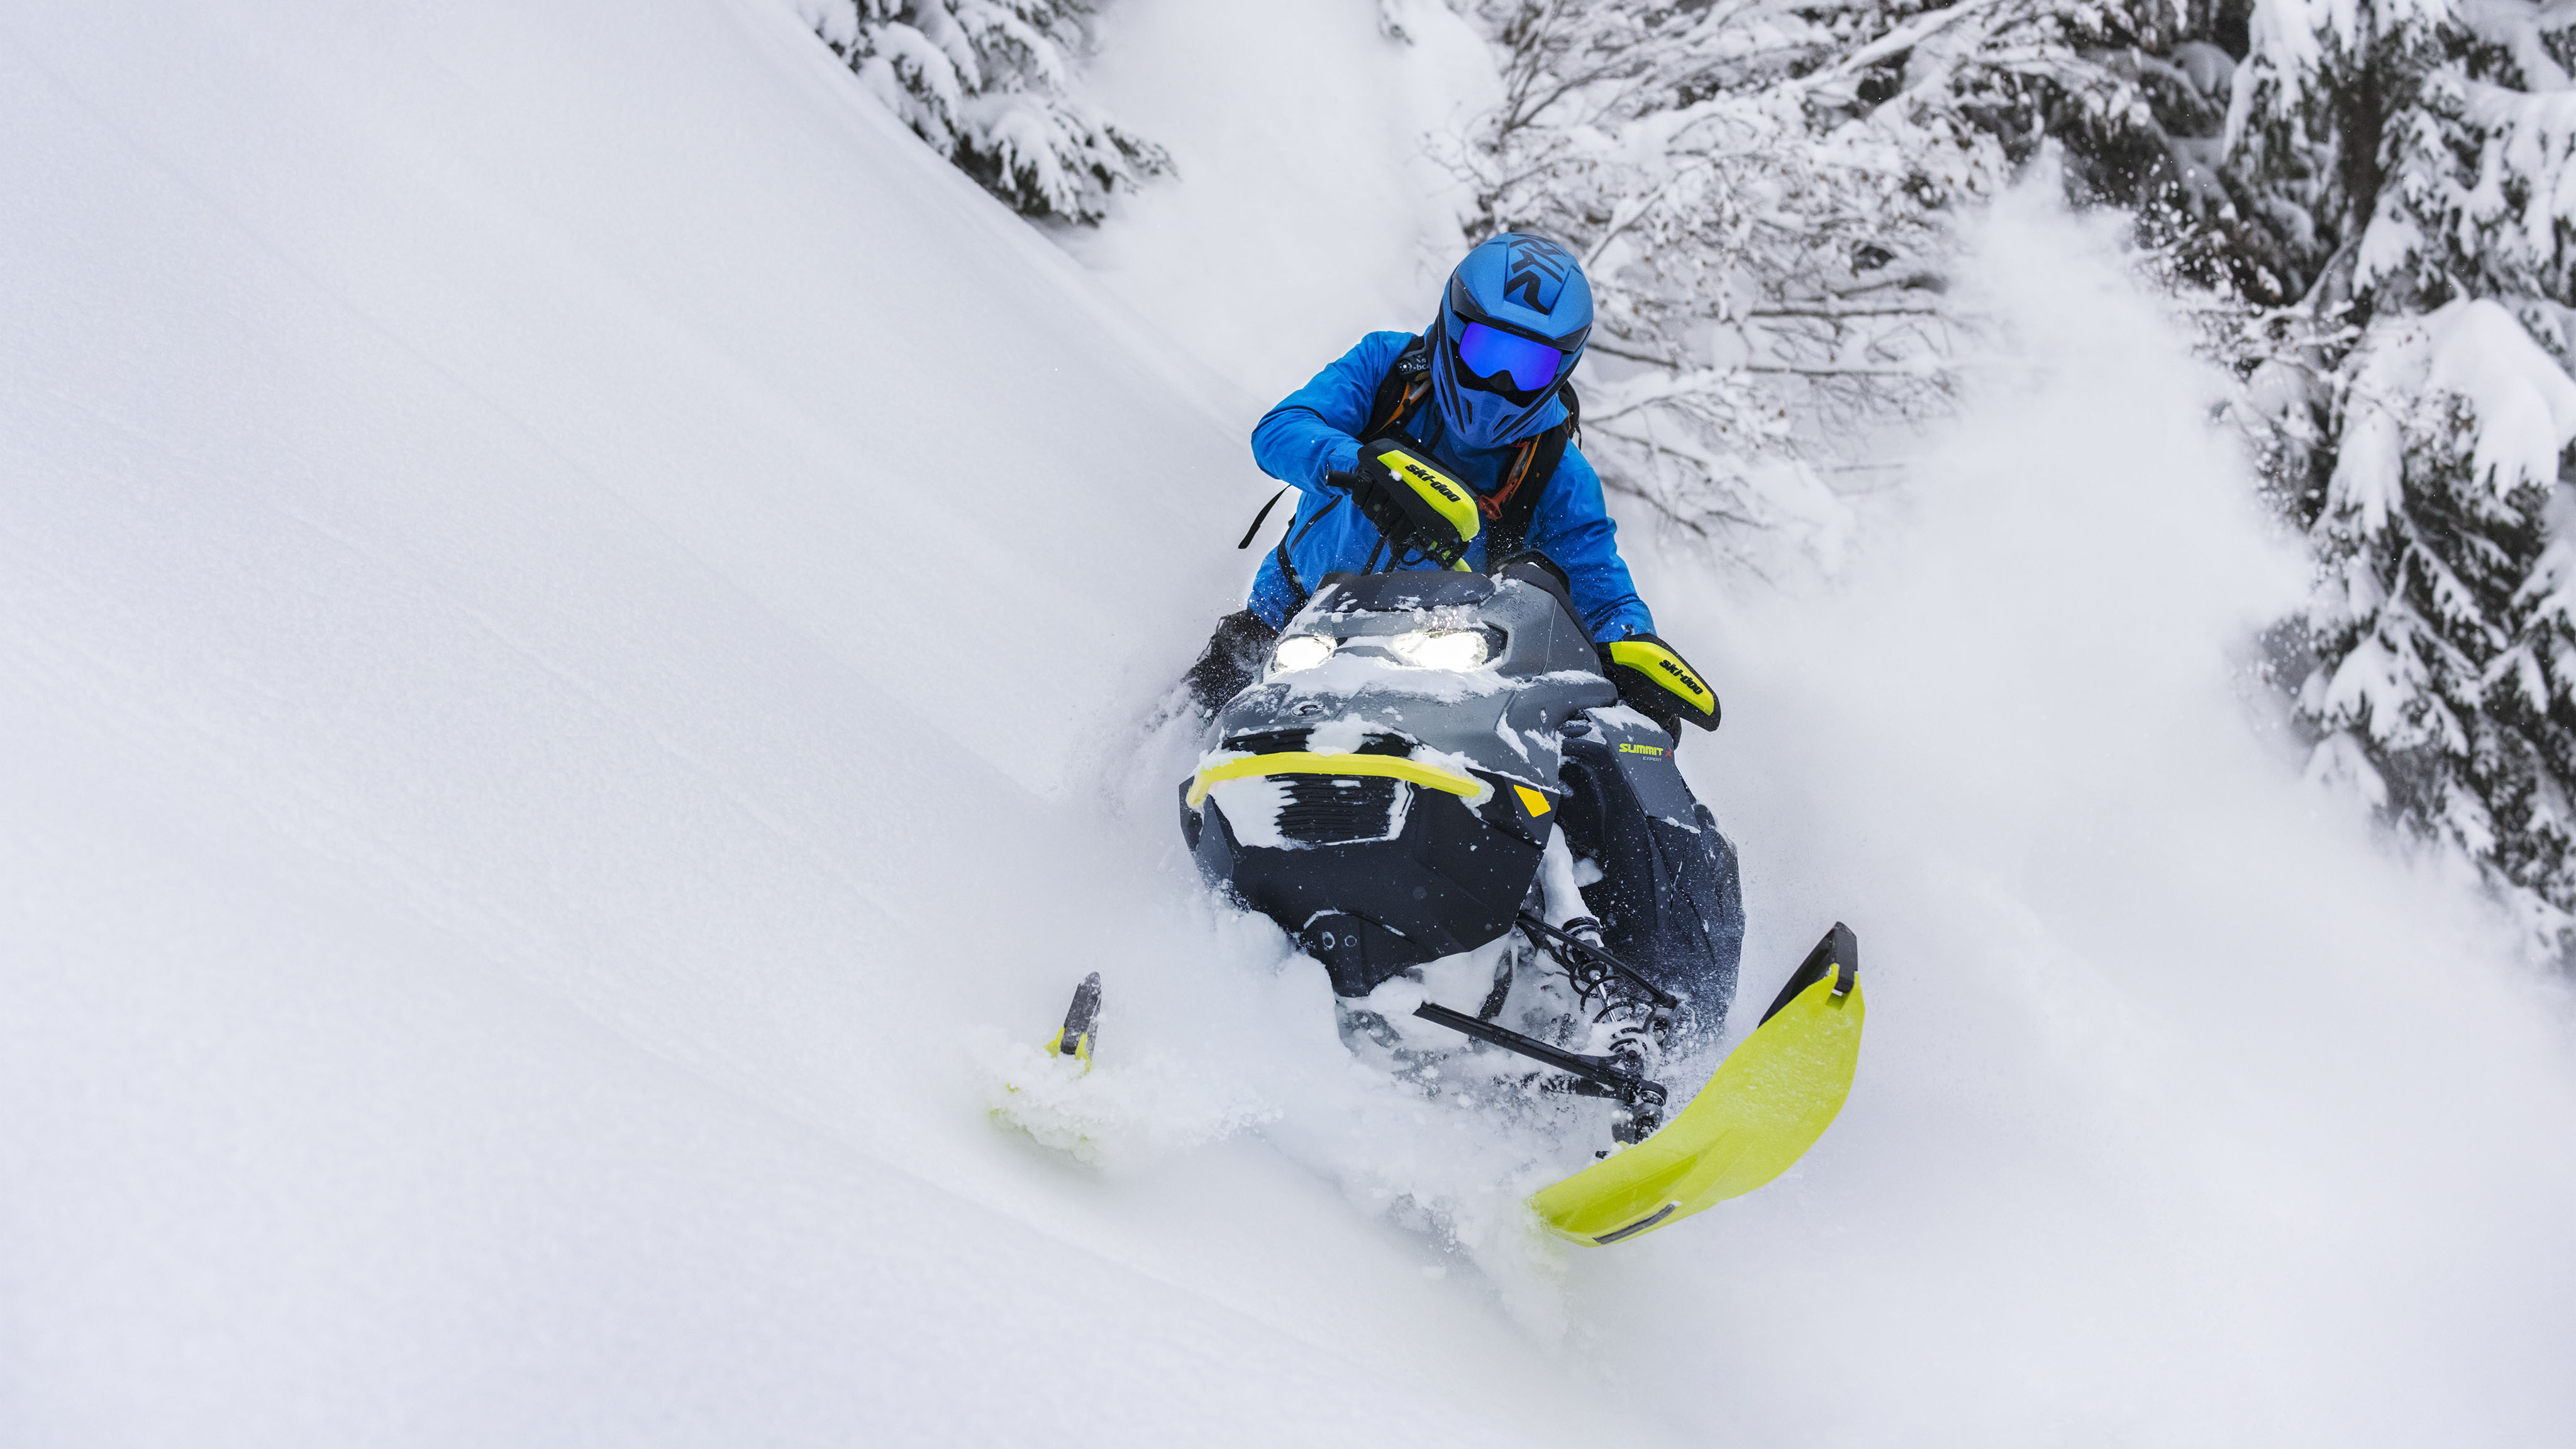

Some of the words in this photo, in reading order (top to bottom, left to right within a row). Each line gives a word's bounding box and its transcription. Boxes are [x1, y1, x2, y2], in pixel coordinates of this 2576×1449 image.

[1404, 464, 1461, 502] ski-doo
[1659, 659, 1704, 695] ski-doo
[1619, 743, 1663, 756] SUMMIT
